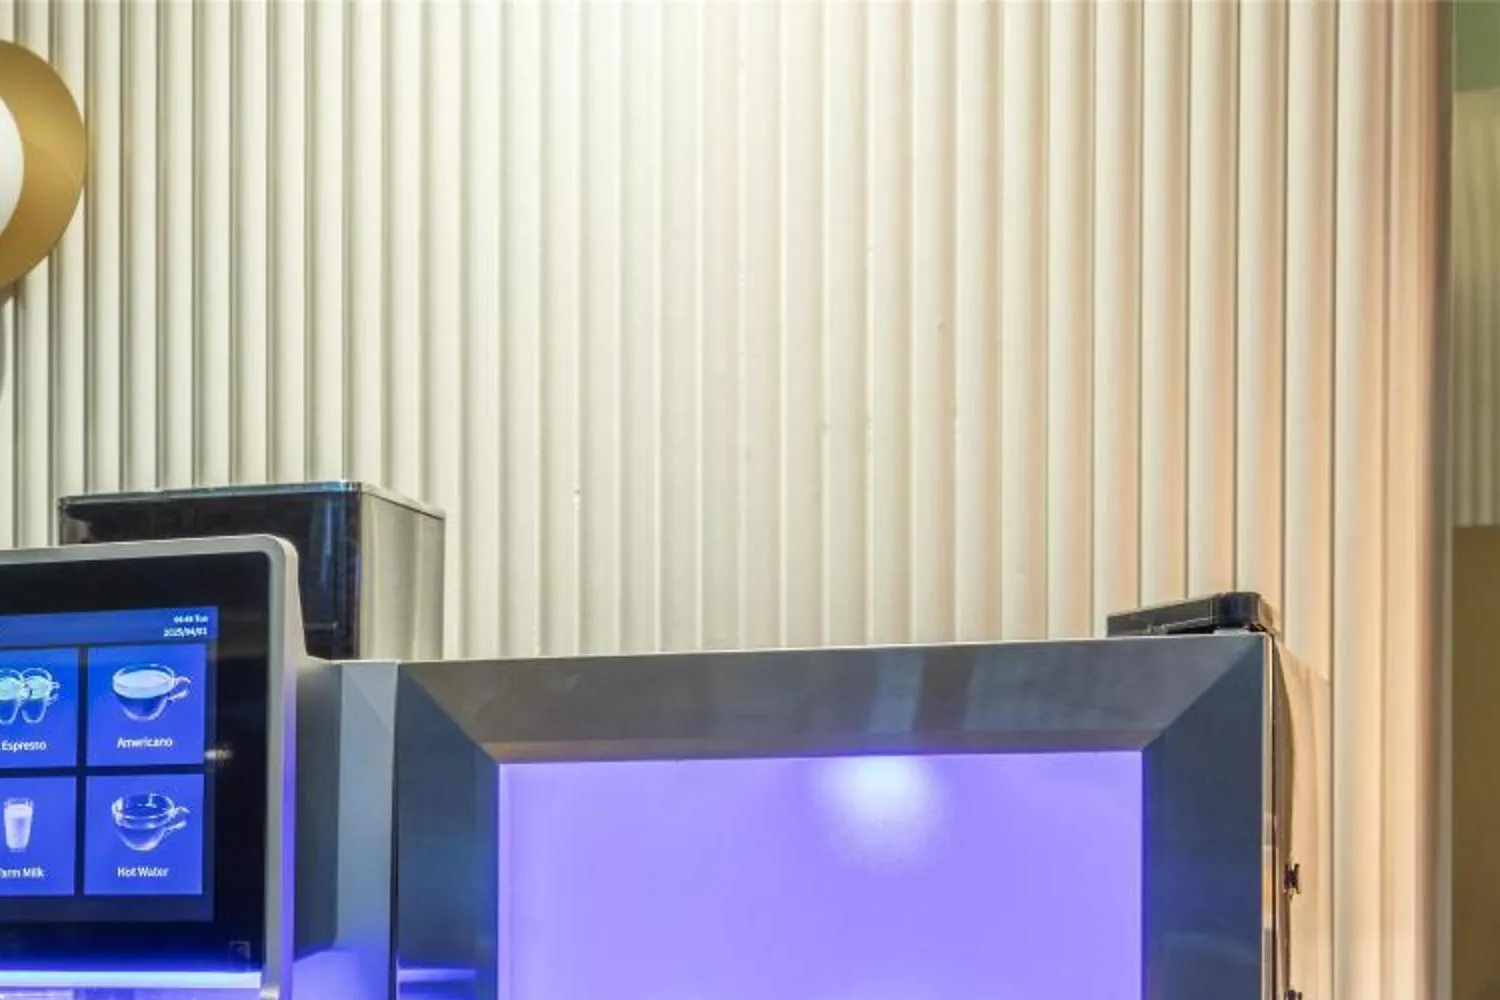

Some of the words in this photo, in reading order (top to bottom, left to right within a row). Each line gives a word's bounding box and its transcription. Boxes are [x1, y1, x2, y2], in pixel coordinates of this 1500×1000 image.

[1, 739, 47, 753] Espresso
[116, 737, 174, 749] Americano
[22, 866, 45, 879] Milk
[117, 866, 137, 878] Hot
[137, 866, 169, 878] Water
